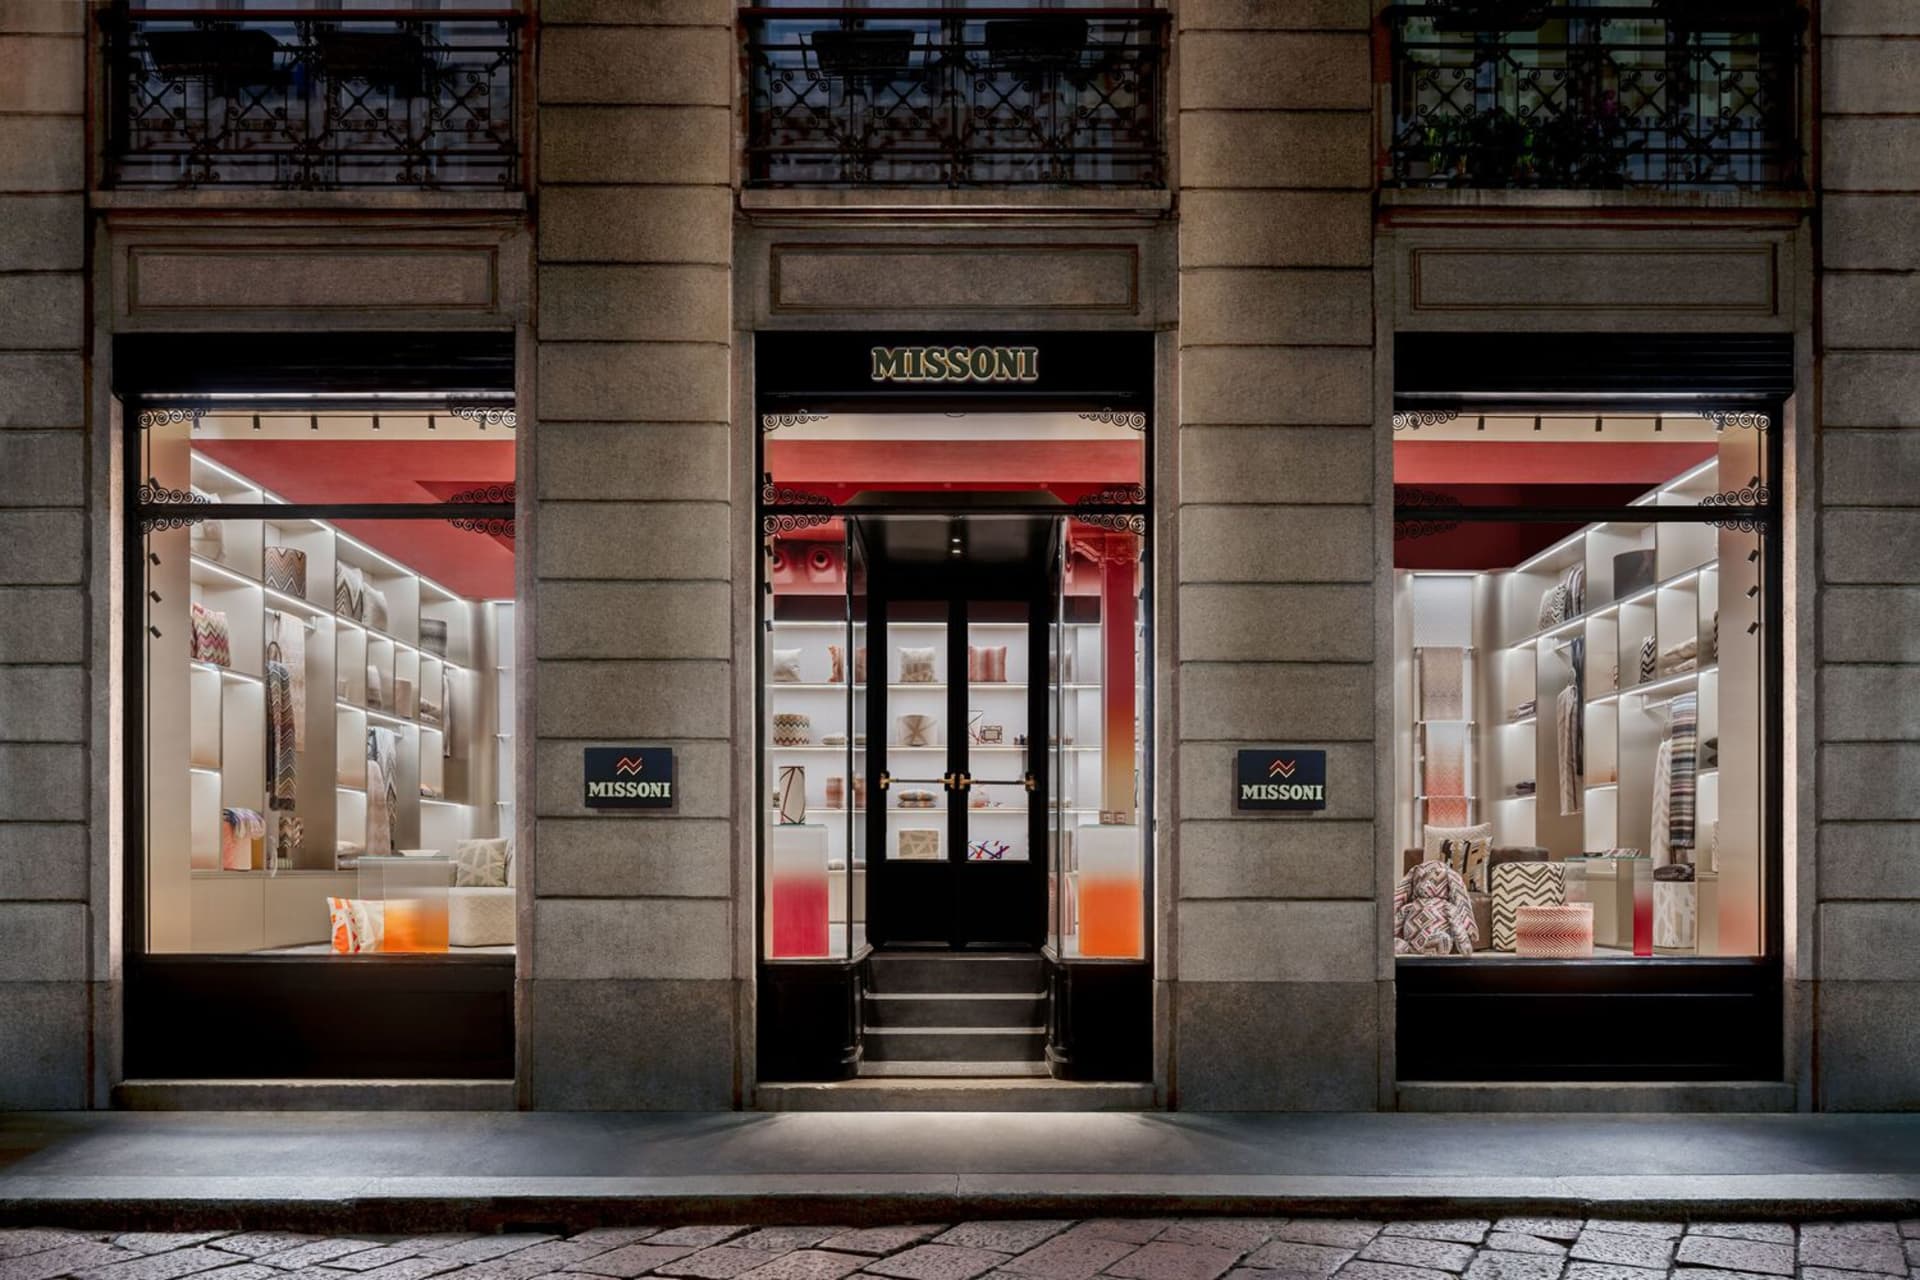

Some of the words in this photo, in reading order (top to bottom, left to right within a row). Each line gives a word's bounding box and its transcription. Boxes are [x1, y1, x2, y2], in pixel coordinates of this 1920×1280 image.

[871, 346, 1039, 381] MISSONI
[588, 782, 671, 798] MISSONI
[1241, 784, 1324, 801] MISSONI
